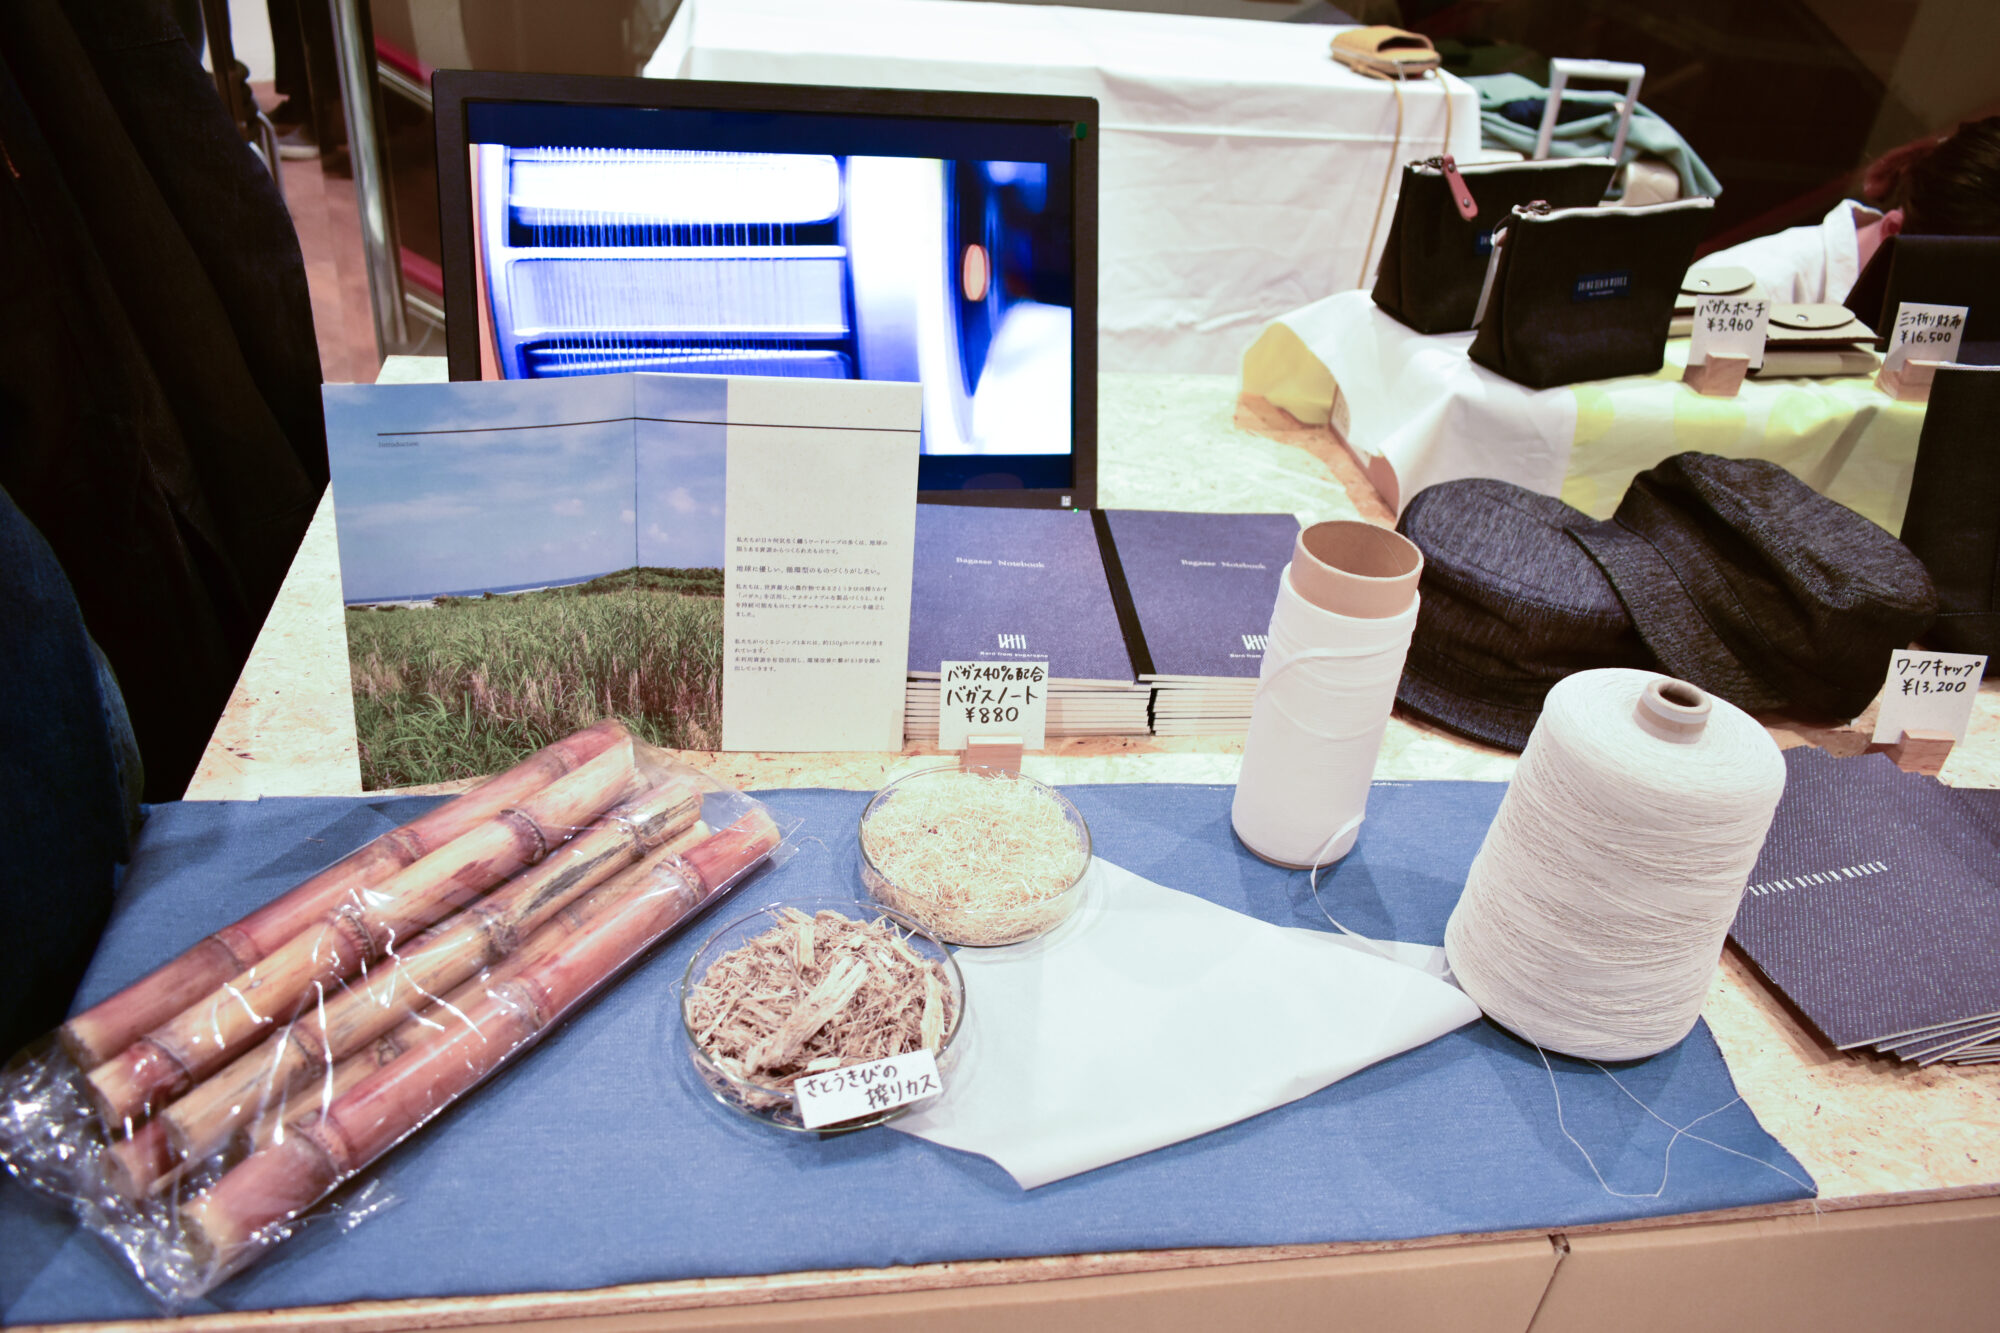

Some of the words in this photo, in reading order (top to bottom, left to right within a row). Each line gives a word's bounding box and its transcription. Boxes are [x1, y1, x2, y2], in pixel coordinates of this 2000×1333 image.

[1699, 299, 1765, 318] バガスポーチ
[1899, 311, 1962, 329] 三つ折り財布
[736, 565, 881, 576] 地球に優しい、循環型のものづくりがしたい。
[956, 557, 992, 565] Bagasse
[998, 560, 1045, 568] Notebook
[1181, 559, 1216, 567] Bagasse
[1221, 561, 1266, 570] Notebook
[947, 663, 1045, 682] バガス40%配合
[1897, 658, 1981, 677] ワークキャップ
[946, 685, 1038, 706] バガスノート
[1901, 678, 1967, 696] ¥13,200
[965, 706, 1019, 724] ¥880
[1749, 879, 1795, 896] SHIMA
[1795, 870, 1842, 889] DENIM
[1841, 860, 1888, 879] WORKS
[804, 1064, 897, 1097] さとうきびの
[865, 1074, 938, 1109] 搾りカス
